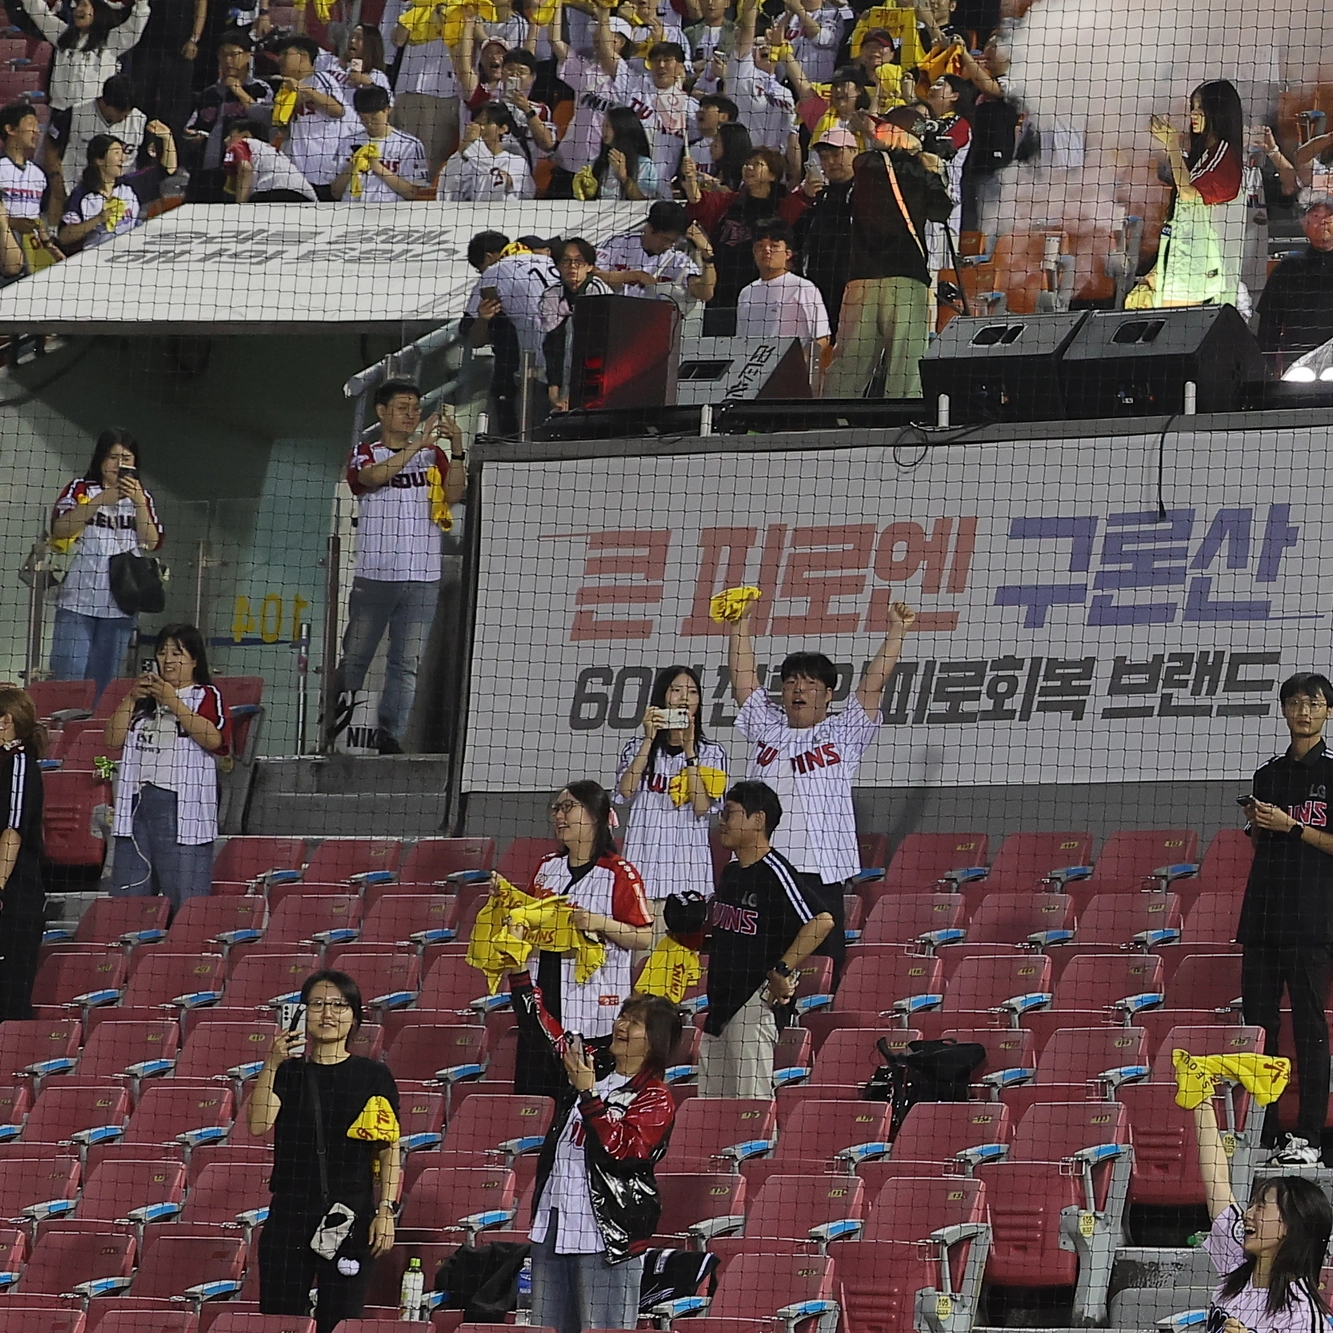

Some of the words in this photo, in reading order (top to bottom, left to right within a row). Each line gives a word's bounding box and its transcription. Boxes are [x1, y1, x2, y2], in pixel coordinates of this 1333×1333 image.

[550, 529, 672, 642] 큰
[680, 514, 978, 638] 피로엔
[998, 503, 1310, 629] 구론산
[880, 654, 1098, 726] 피로회복
[1099, 652, 1283, 719] 브랜드
[347, 727, 380, 749] NIK
[1308, 783, 1327, 798] LG
